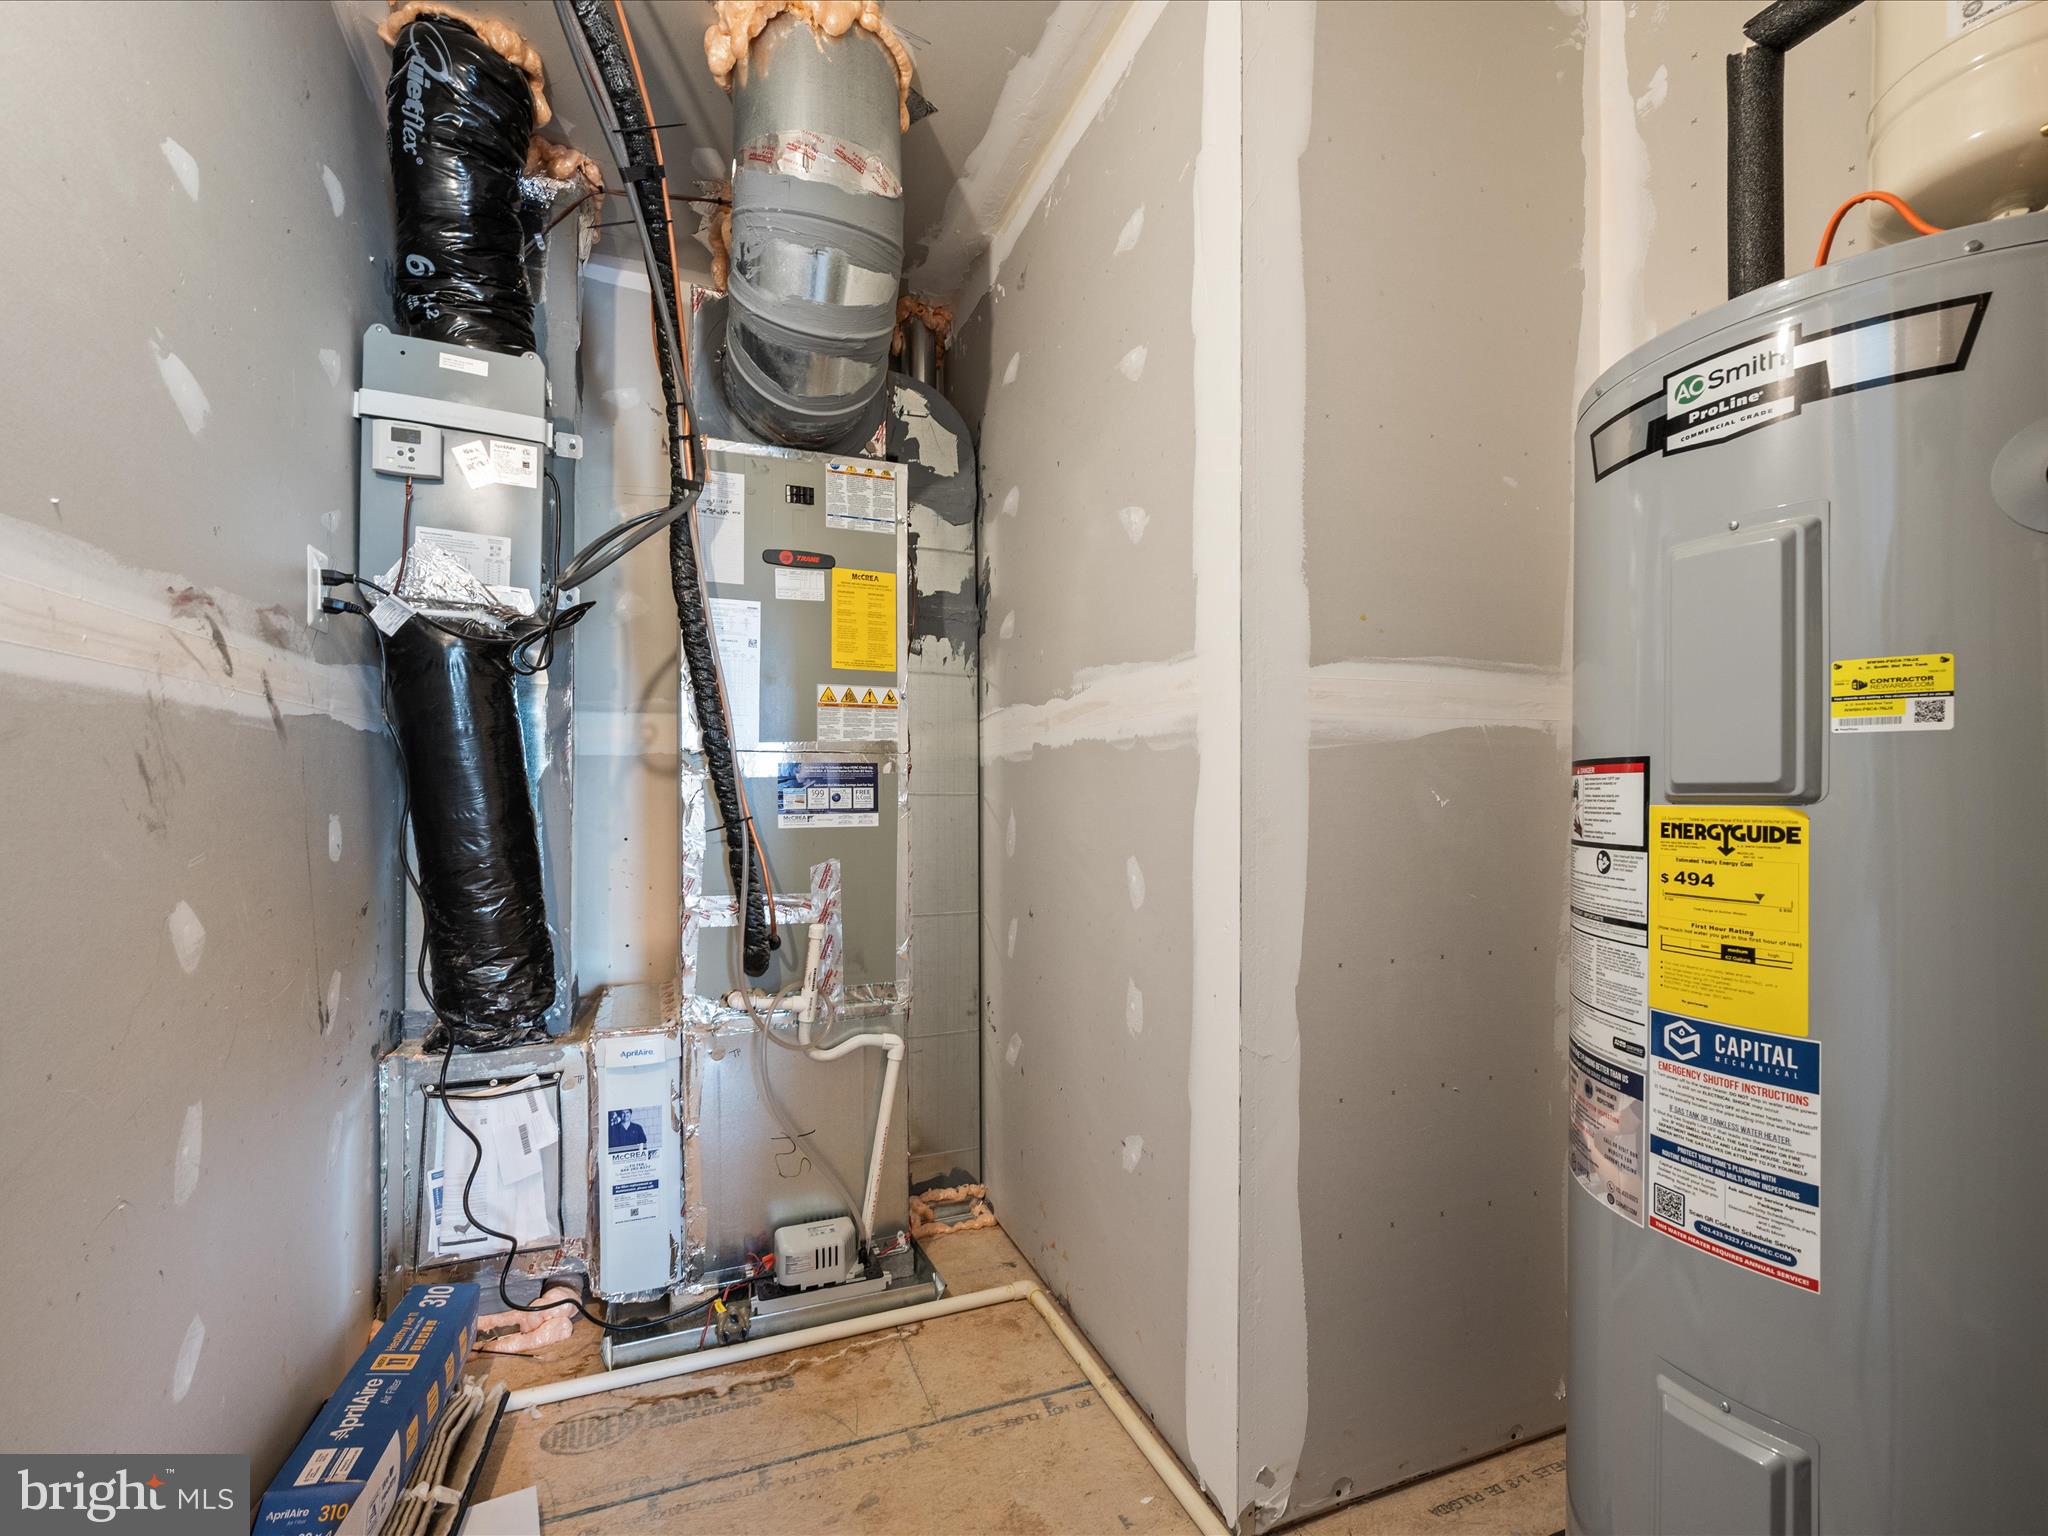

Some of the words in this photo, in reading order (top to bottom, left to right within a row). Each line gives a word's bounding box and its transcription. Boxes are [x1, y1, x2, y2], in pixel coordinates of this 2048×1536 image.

[405, 253, 435, 277] 6
[1674, 377, 1706, 403] AO
[1707, 348, 1790, 390] Smith
[1688, 391, 1762, 424] ProLine
[1680, 419, 1736, 442] COMMERCIAL
[1740, 408, 1774, 422] GRADE
[796, 555, 821, 563] TRANE
[851, 573, 880, 582] McCREA
[1869, 675, 1934, 684] CONTRACTOR
[1869, 682, 1935, 690] REWARDS.COM
[1660, 822, 1802, 846] ENERGYGUIDE
[1660, 872, 1669, 884] $
[1673, 871, 1715, 888] 494
[1691, 922, 1707, 931] First
[1709, 924, 1727, 932] Hour
[1728, 927, 1755, 937] Rating
[1720, 933, 1731, 941] get
[619, 1049, 653, 1058] AprilAire
[1715, 1033, 1799, 1068] CAPITAL
[1715, 1055, 1799, 1079] MECHANICAL
[1658, 1061, 1701, 1080] EMERGENCY
[1703, 1073, 1740, 1090] SHUTOFF
[1741, 1082, 1809, 1107] INSTRUCTIONS
[1728, 1089, 1737, 1097] DO
[1737, 1091, 1749, 1100] NOT
[1703, 1090, 1731, 1101] ELECTRICAL
[1732, 1098, 1751, 1106] SHOCK
[1674, 1105, 1685, 1116] GAS
[1686, 1109, 1700, 1121] TANK
[1700, 1113, 1708, 1123] OR
[1710, 1116, 1739, 1132] TANKLESS
[1741, 1125, 1763, 1138] WATER
[1750, 1110, 1765, 1118] water
[1798, 1121, 1818, 1131] shutoff
[1776, 1123, 1791, 1131] water
[1659, 1121, 1686, 1134] DEPARTMENT
[1719, 1141, 1730, 1149] AND
[1731, 1145, 1747, 1153] LEAVE
[1791, 1162, 1805, 1170] NOT
[1685, 1124, 1700, 1133] SMELL
[1712, 1133, 1726, 1142] CALL
[1726, 1137, 1736, 1145] THE
[1737, 1140, 1748, 1148] GAS
[1750, 1144, 1777, 1155] COMPANY
[1778, 1151, 1787, 1159] OR
[1787, 1153, 1801, 1162] FIRE
[612, 1151, 647, 1161] McCREA
[1678, 1146, 1697, 1157] PROTECT
[1697, 1153, 1711, 1162] YOUR
[1712, 1157, 1731, 1169] HOME'S
[1732, 1164, 1760, 1178] PLUMBING
[1761, 1172, 1776, 1183] WITH
[1694, 1139, 1704, 1147] GAS
[1705, 1144, 1723, 1152] VALVES
[1723, 1148, 1732, 1156] OR
[1733, 1152, 1757, 1163] ATTEMPT
[1767, 1161, 1777, 1169] FIX
[1778, 1164, 1808, 1177] YOURSELF
[1662, 1149, 1680, 1159] ROUTINE
[1681, 1156, 1714, 1172] MAINTENANCE
[1714, 1167, 1725, 1177] AND
[1727, 1171, 1761, 1188] MULTI-POINT
[1762, 1182, 1800, 1200] INSPECTIONS
[1727, 1184, 1737, 1192] Ask
[1738, 1188, 1753, 1196] about
[1764, 1197, 1784, 1206] Service
[1785, 1202, 1816, 1217] Agreement
[1757, 1202, 1783, 1214] Packages
[1689, 1209, 1704, 1218] Scan
[1704, 1215, 1714, 1223] QR
[1715, 1218, 1731, 1229] Code
[1732, 1225, 1740, 1233] to
[1741, 1228, 1772, 1244] Schedule
[1774, 1239, 1802, 1254] Service
[1655, 1221, 1667, 1230] THIS
[1668, 1227, 1686, 1239] WATER
[1688, 1235, 1711, 1249] HEATER
[1712, 1245, 1743, 1262] REQUIRES
[1744, 1258, 1775, 1274] ANNUAL
[1777, 1269, 1809, 1287] SERVICE!
[1744, 1240, 1792, 1263] CAPMEC.COM
[418, 1285, 455, 1308] 310
[385, 1379, 402, 1395] Filter
[329, 1378, 384, 1441] AprilAire
[380, 1394, 391, 1405] Air
[1484, 1483, 1505, 1497] DE
[265, 1508, 310, 1524] AprilAire
[317, 1503, 349, 1522] 310
[1428, 1490, 1486, 1518] PULGADA
